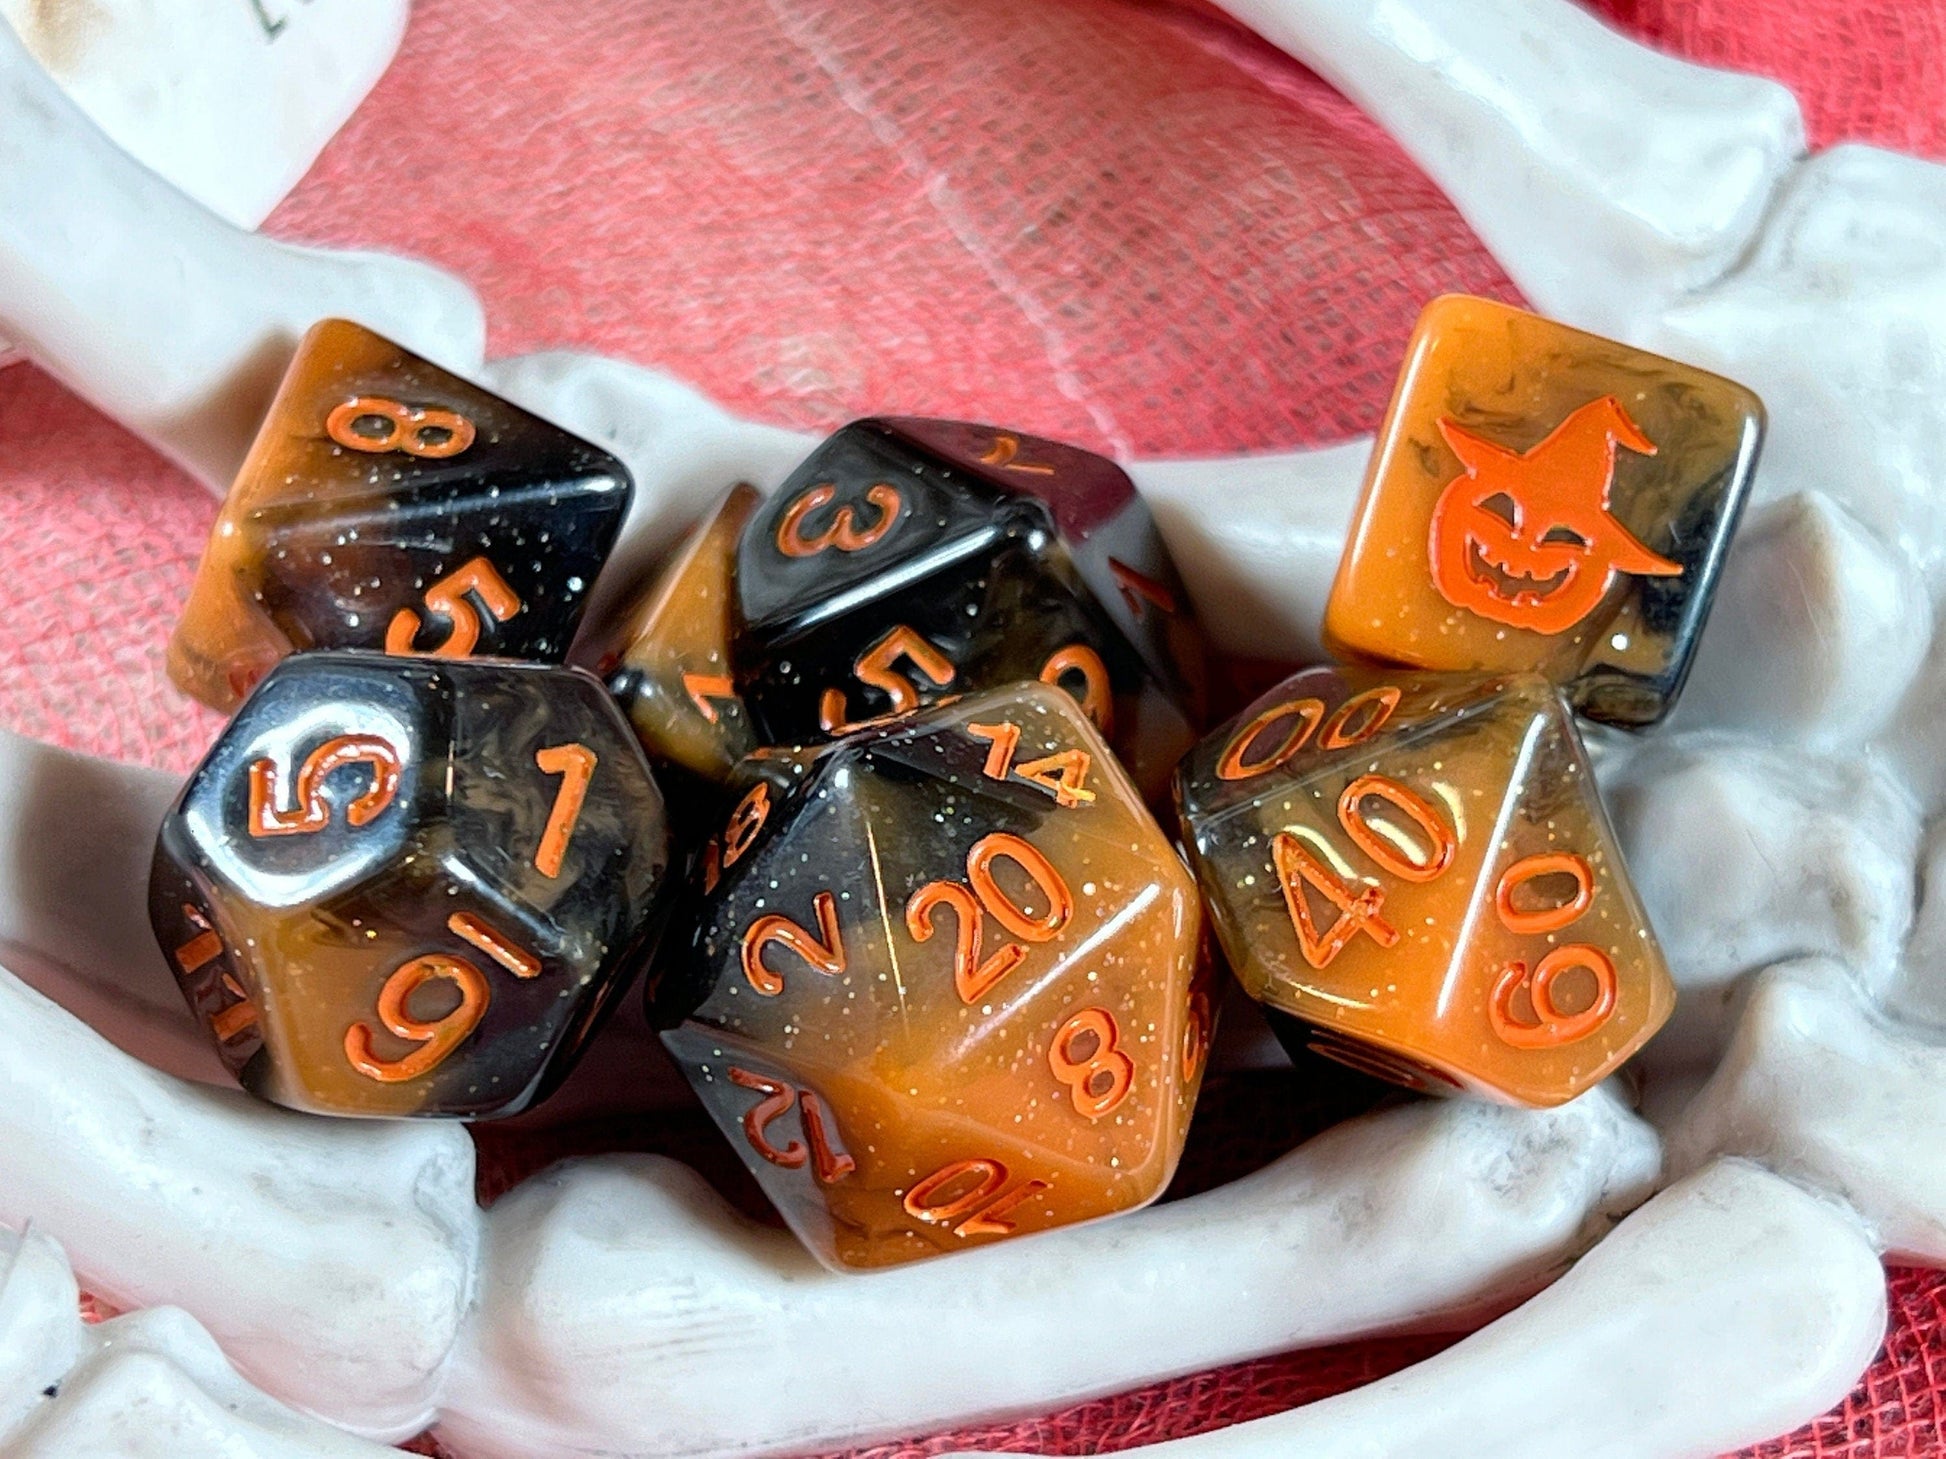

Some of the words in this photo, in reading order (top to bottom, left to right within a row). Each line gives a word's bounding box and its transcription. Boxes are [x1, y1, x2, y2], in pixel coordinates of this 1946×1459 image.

[327, 397, 477, 459] 8
[776, 483, 901, 557] 3
[385, 556, 521, 657] 5
[819, 624, 956, 737] 5
[248, 733, 400, 838] 5
[535, 743, 597, 878] 1
[967, 722, 1097, 809] 14
[906, 832, 1073, 1004] 20
[1272, 774, 1455, 969] 40
[742, 892, 846, 996] 2
[1048, 1007, 1134, 1119] 8
[727, 1066, 856, 1184] 12
[903, 1158, 1048, 1236] 10
